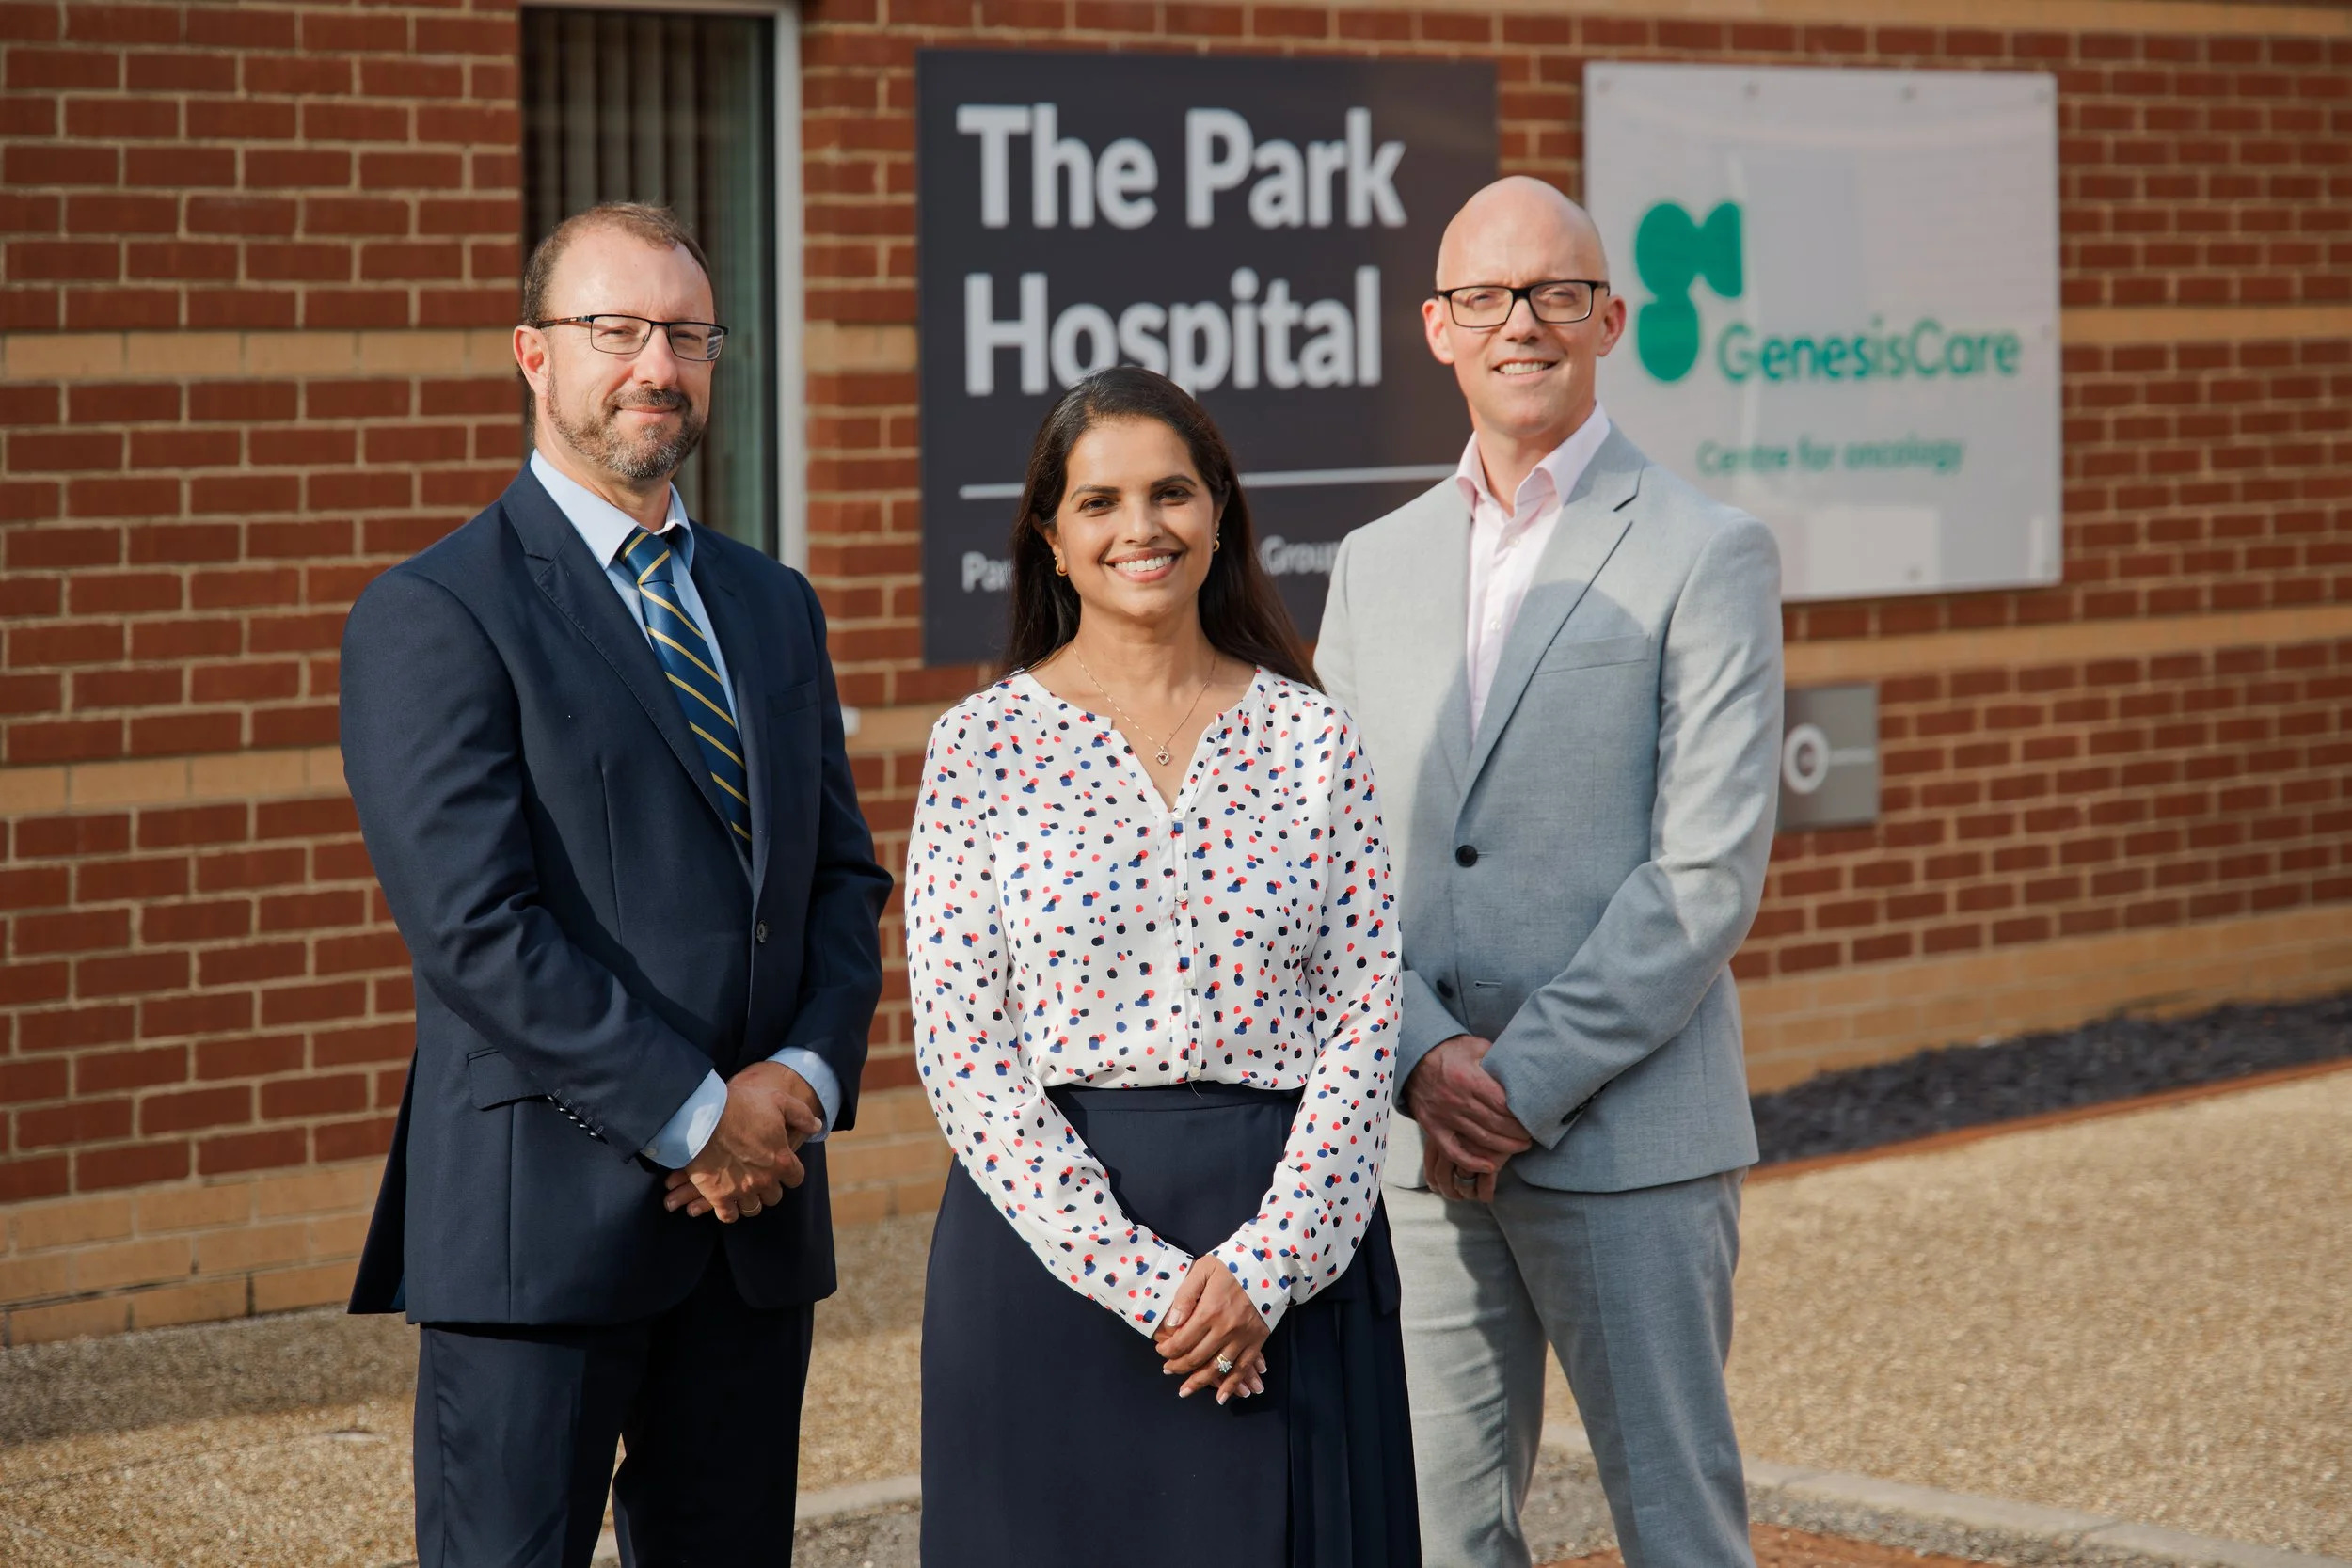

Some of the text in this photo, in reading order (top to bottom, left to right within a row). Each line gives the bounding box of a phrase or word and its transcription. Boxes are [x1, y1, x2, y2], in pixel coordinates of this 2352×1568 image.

[957, 103, 1407, 229] The Park
[964, 264, 1381, 400] Hospital
[1718, 314, 2021, 382] GenesisCare
